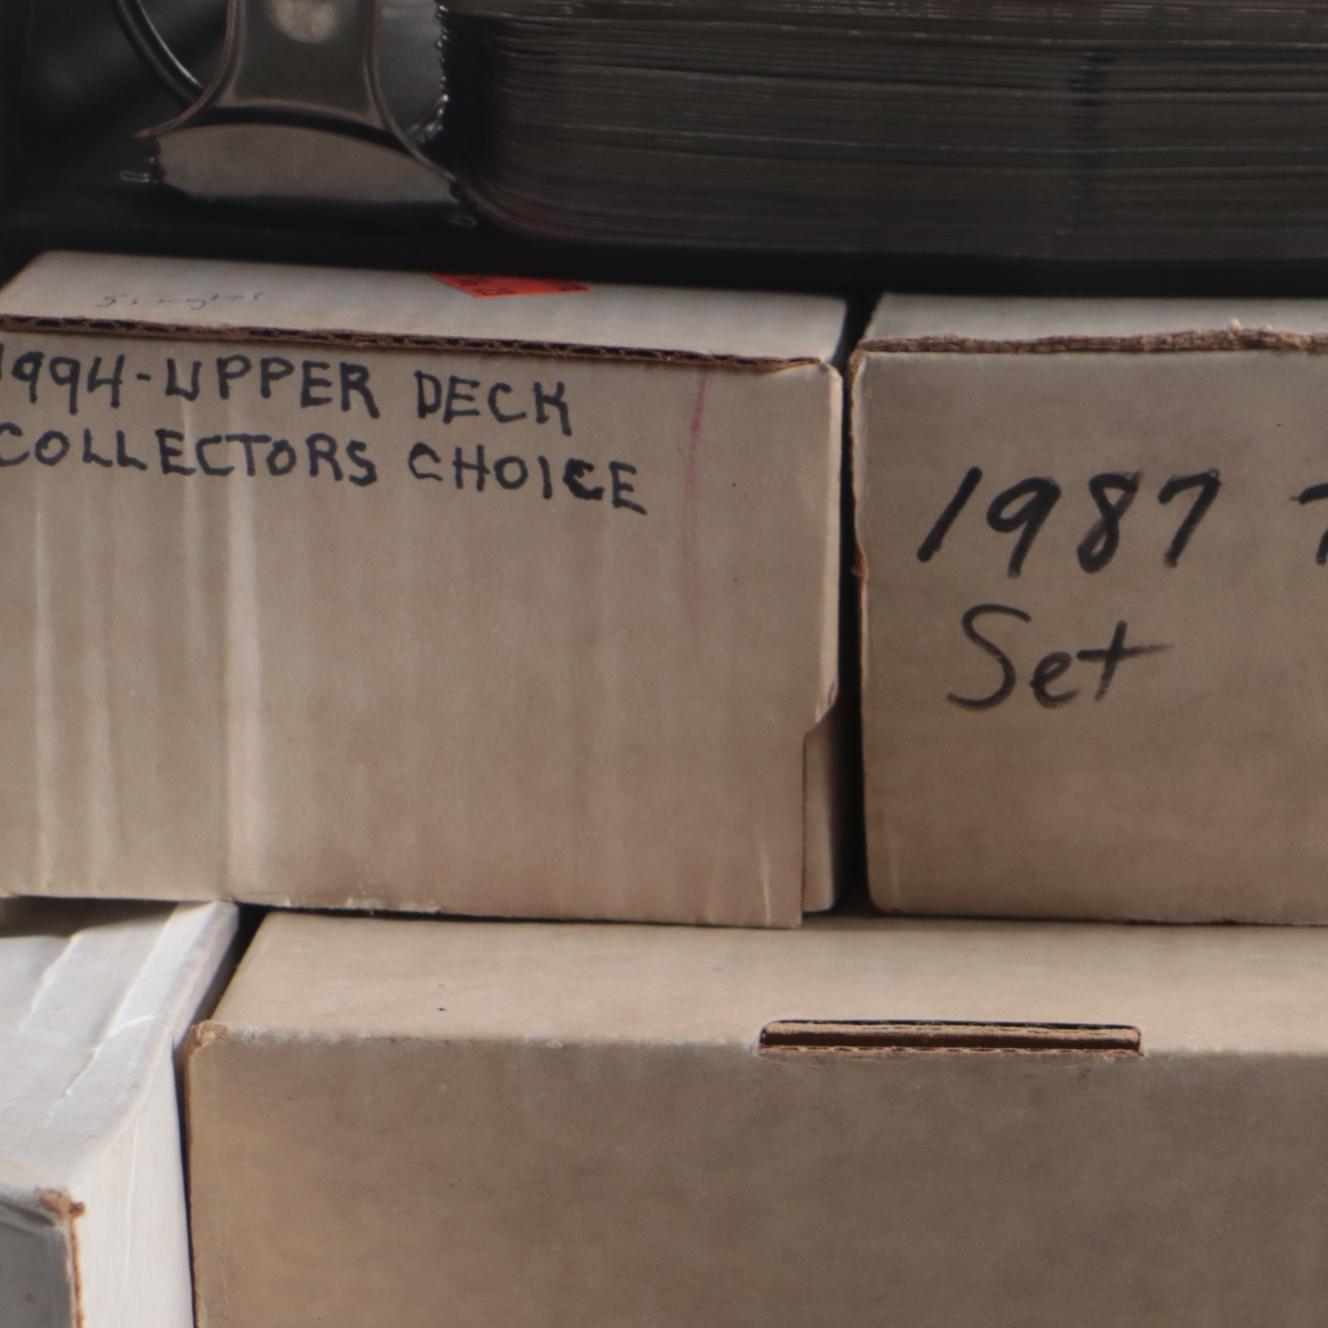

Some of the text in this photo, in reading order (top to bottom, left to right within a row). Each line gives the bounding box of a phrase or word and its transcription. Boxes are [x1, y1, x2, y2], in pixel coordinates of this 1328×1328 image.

[414, 371, 572, 436] DECK
[0, 422, 648, 516] COLLECTORS CHOICE
[917, 466, 1222, 579] 1987
[947, 602, 1171, 710] Set
